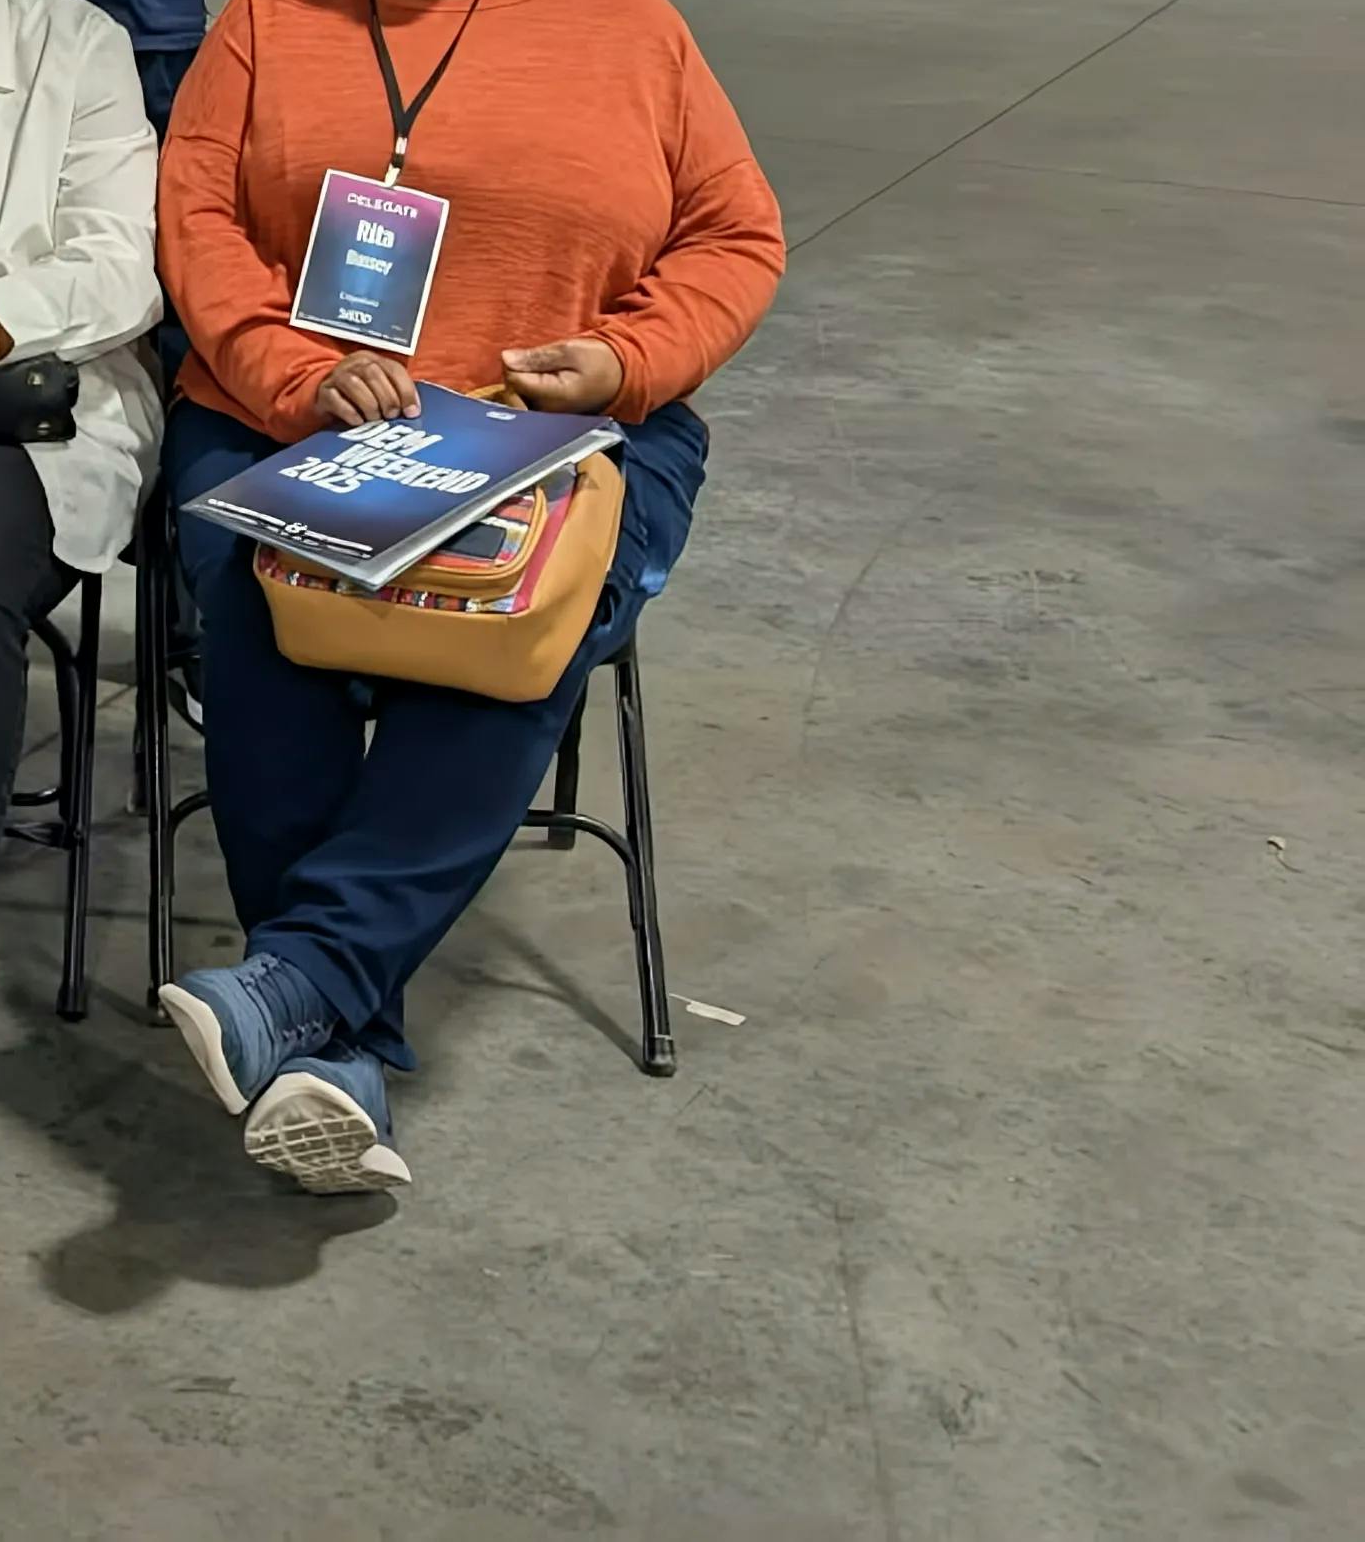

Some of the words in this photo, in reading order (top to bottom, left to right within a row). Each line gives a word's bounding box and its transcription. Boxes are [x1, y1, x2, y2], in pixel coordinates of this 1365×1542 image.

[356, 219, 395, 248] Rita
[338, 420, 444, 456] DEM
[278, 457, 375, 494] 2025
[332, 444, 490, 494] WEEKEND
